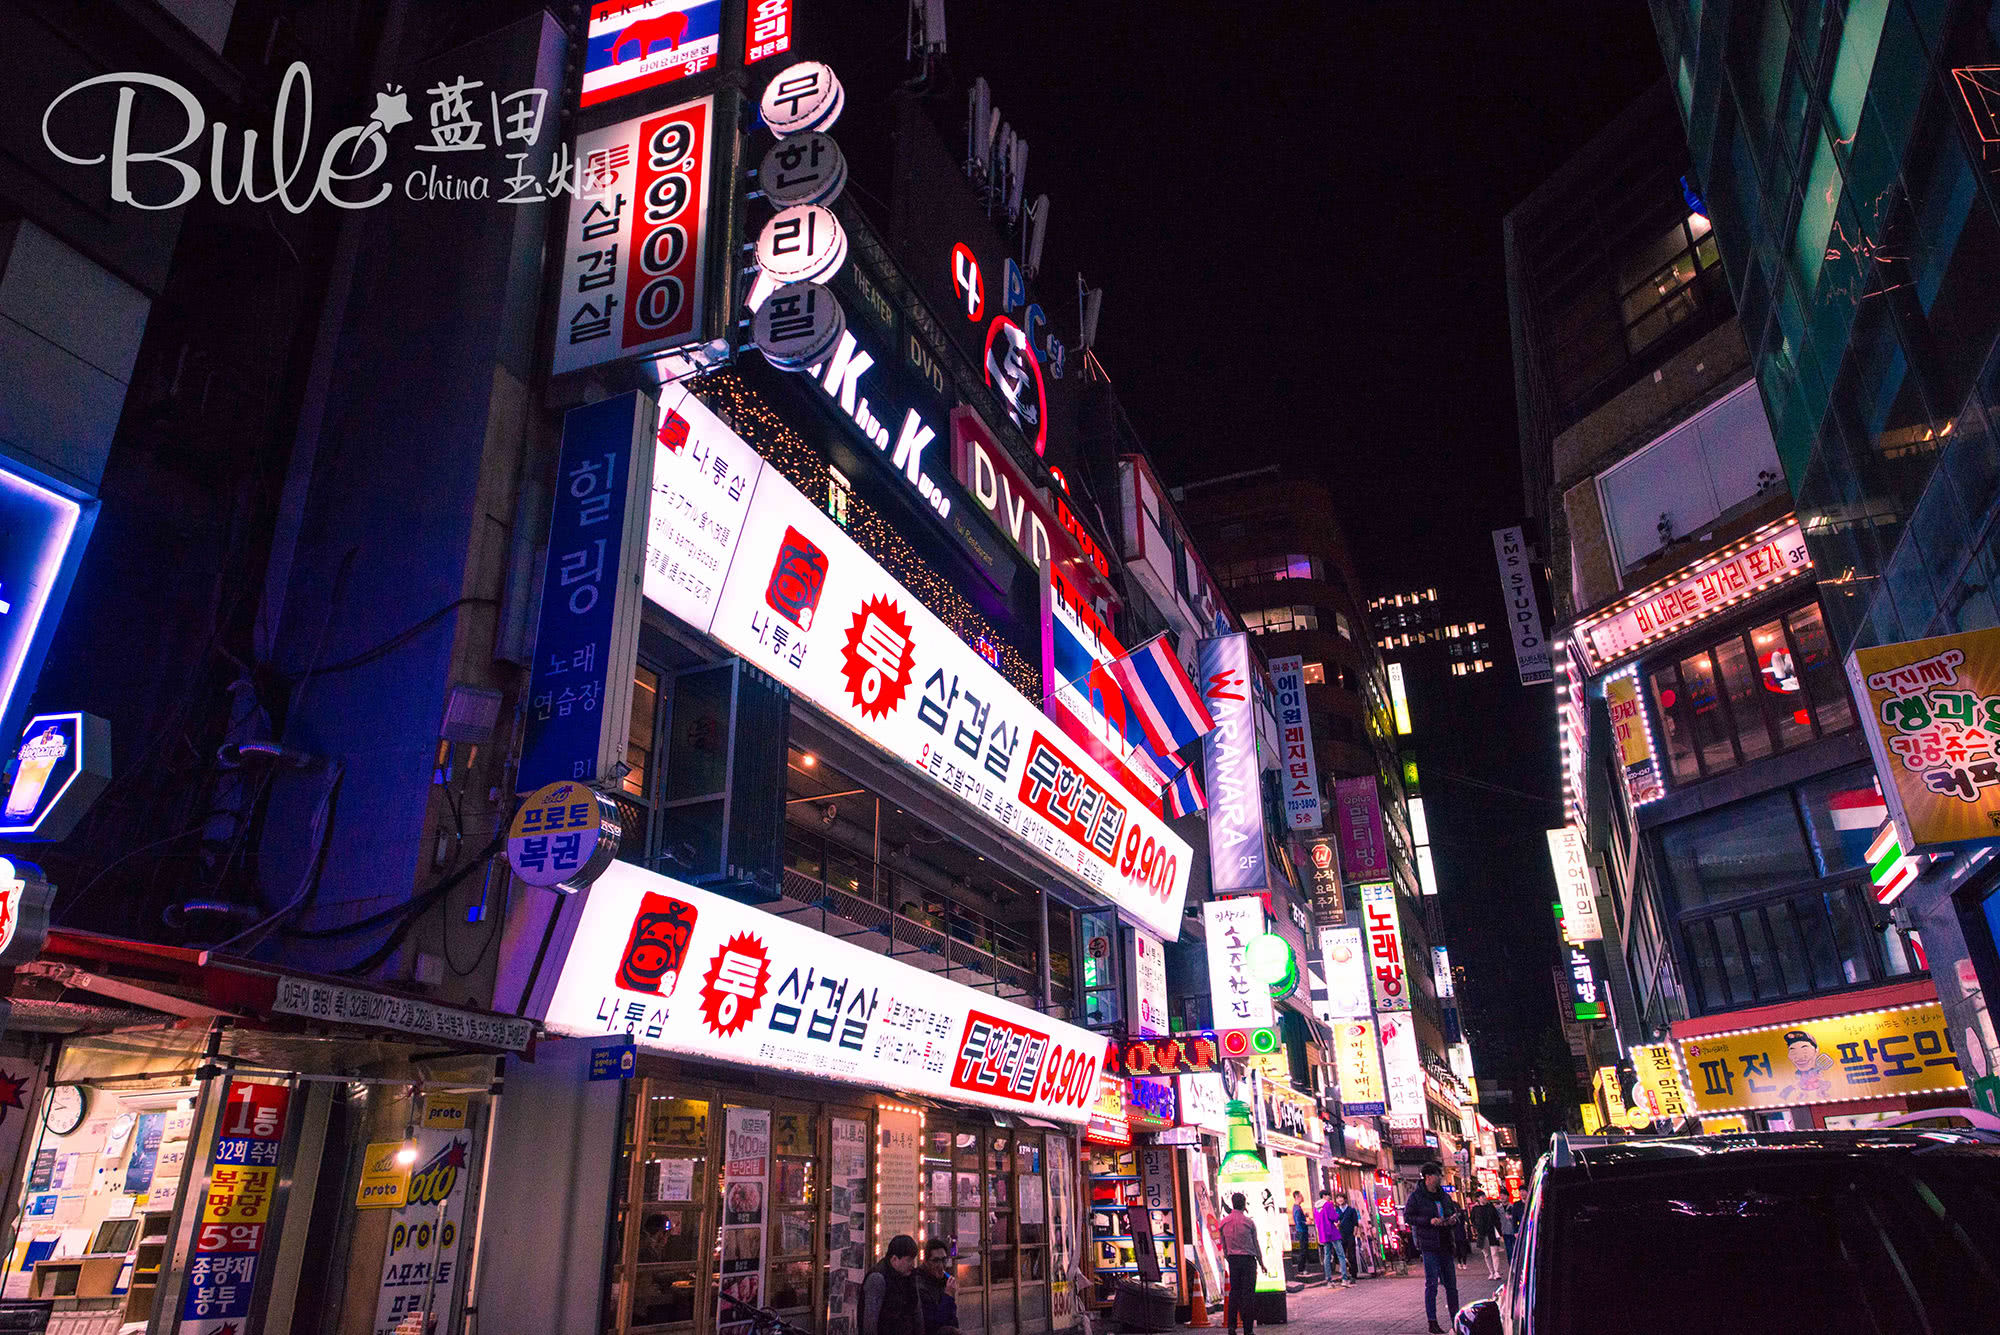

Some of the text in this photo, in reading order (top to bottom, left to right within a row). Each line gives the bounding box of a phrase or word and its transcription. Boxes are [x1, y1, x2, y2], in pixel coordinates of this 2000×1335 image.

[684, 57, 709, 76] 3F
[853, 262, 943, 394] THEATER DVD
[970, 440, 1051, 568] DVD
[560, 451, 617, 615] 힐링
[1503, 532, 1520, 567] EMS
[1633, 606, 1654, 634] 비
[1650, 588, 1700, 626] 내리는
[1696, 559, 1749, 603] 길거리
[1788, 544, 1809, 564] 3F
[1511, 573, 1539, 649] STUDIO
[533, 680, 602, 722] 연습장
[1277, 674, 1314, 797] 에이원 레지던스
[1205, 668, 1250, 850] WARAWARA
[916, 667, 1020, 783] 삼겹살
[1027, 747, 1124, 855] 무한리필
[1120, 823, 1178, 905] 9,900
[520, 803, 589, 833] 프로토
[519, 832, 582, 873] 복권
[1349, 806, 1377, 868] 멀티방
[1239, 855, 1258, 870] 2F
[1313, 869, 1335, 882] 수작
[1315, 882, 1337, 896] 요리
[1316, 896, 1339, 908] 주가
[1367, 903, 1404, 997] 노래방
[1570, 949, 1597, 1003] 노래방
[768, 966, 879, 1051] 삼겹살
[961, 1019, 1047, 1095] 무한리필
[1040, 1043, 1097, 1109] 9,900
[1650, 1047, 1672, 1071] 파전
[1699, 1051, 1778, 1096] 파전
[229, 1084, 279, 1137] 1등
[428, 1106, 463, 1121] proto
[1658, 1078, 1685, 1115] 막걸리
[216, 1140, 279, 1164] 32회 즉석
[211, 1169, 271, 1195] 복권
[362, 1183, 399, 1200] proto
[208, 1195, 267, 1218] 명당
[199, 1224, 258, 1250] 5억
[191, 1255, 257, 1287] 종량제
[194, 1286, 237, 1316] 봉투
